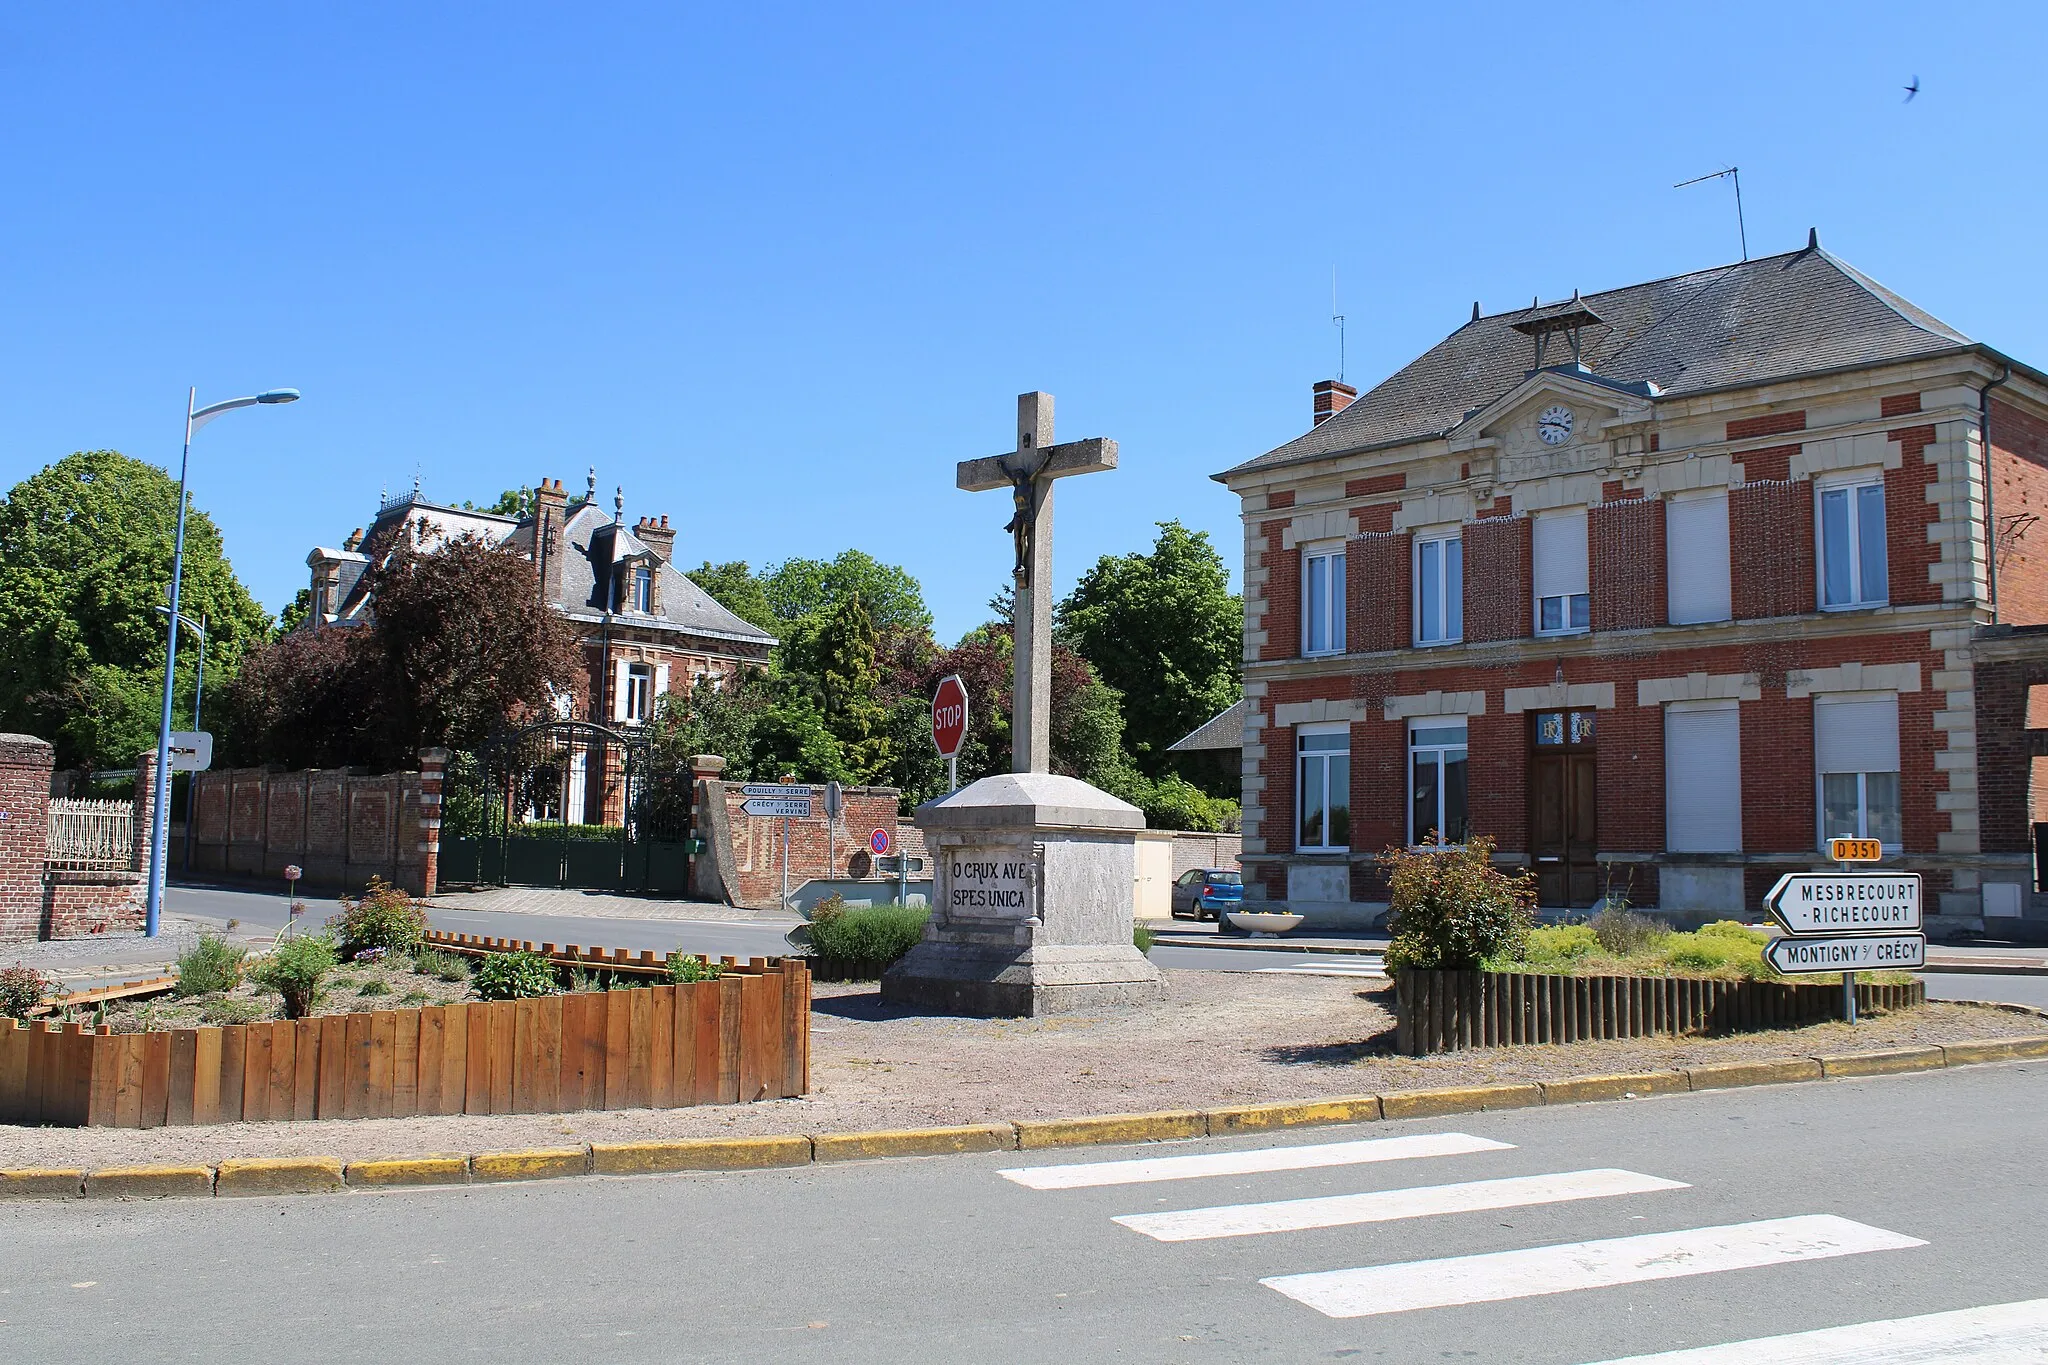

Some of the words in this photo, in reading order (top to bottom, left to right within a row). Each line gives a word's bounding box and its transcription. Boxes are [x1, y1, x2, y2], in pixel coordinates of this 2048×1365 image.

[1510, 448, 1600, 475] MAIRIE
[935, 704, 962, 730] STOP
[1837, 842, 1846, 858] D
[1850, 842, 1877, 858] 351
[953, 862, 962, 878] O
[964, 862, 999, 884] CRUX
[1002, 863, 1027, 879] AVE
[952, 889, 986, 906] SPES
[988, 890, 1025, 908] UNICA
[1802, 884, 1914, 901] MESBRECOURT
[1788, 945, 1859, 964] MONTIGNY
[1877, 940, 1919, 960] CRÉCY
